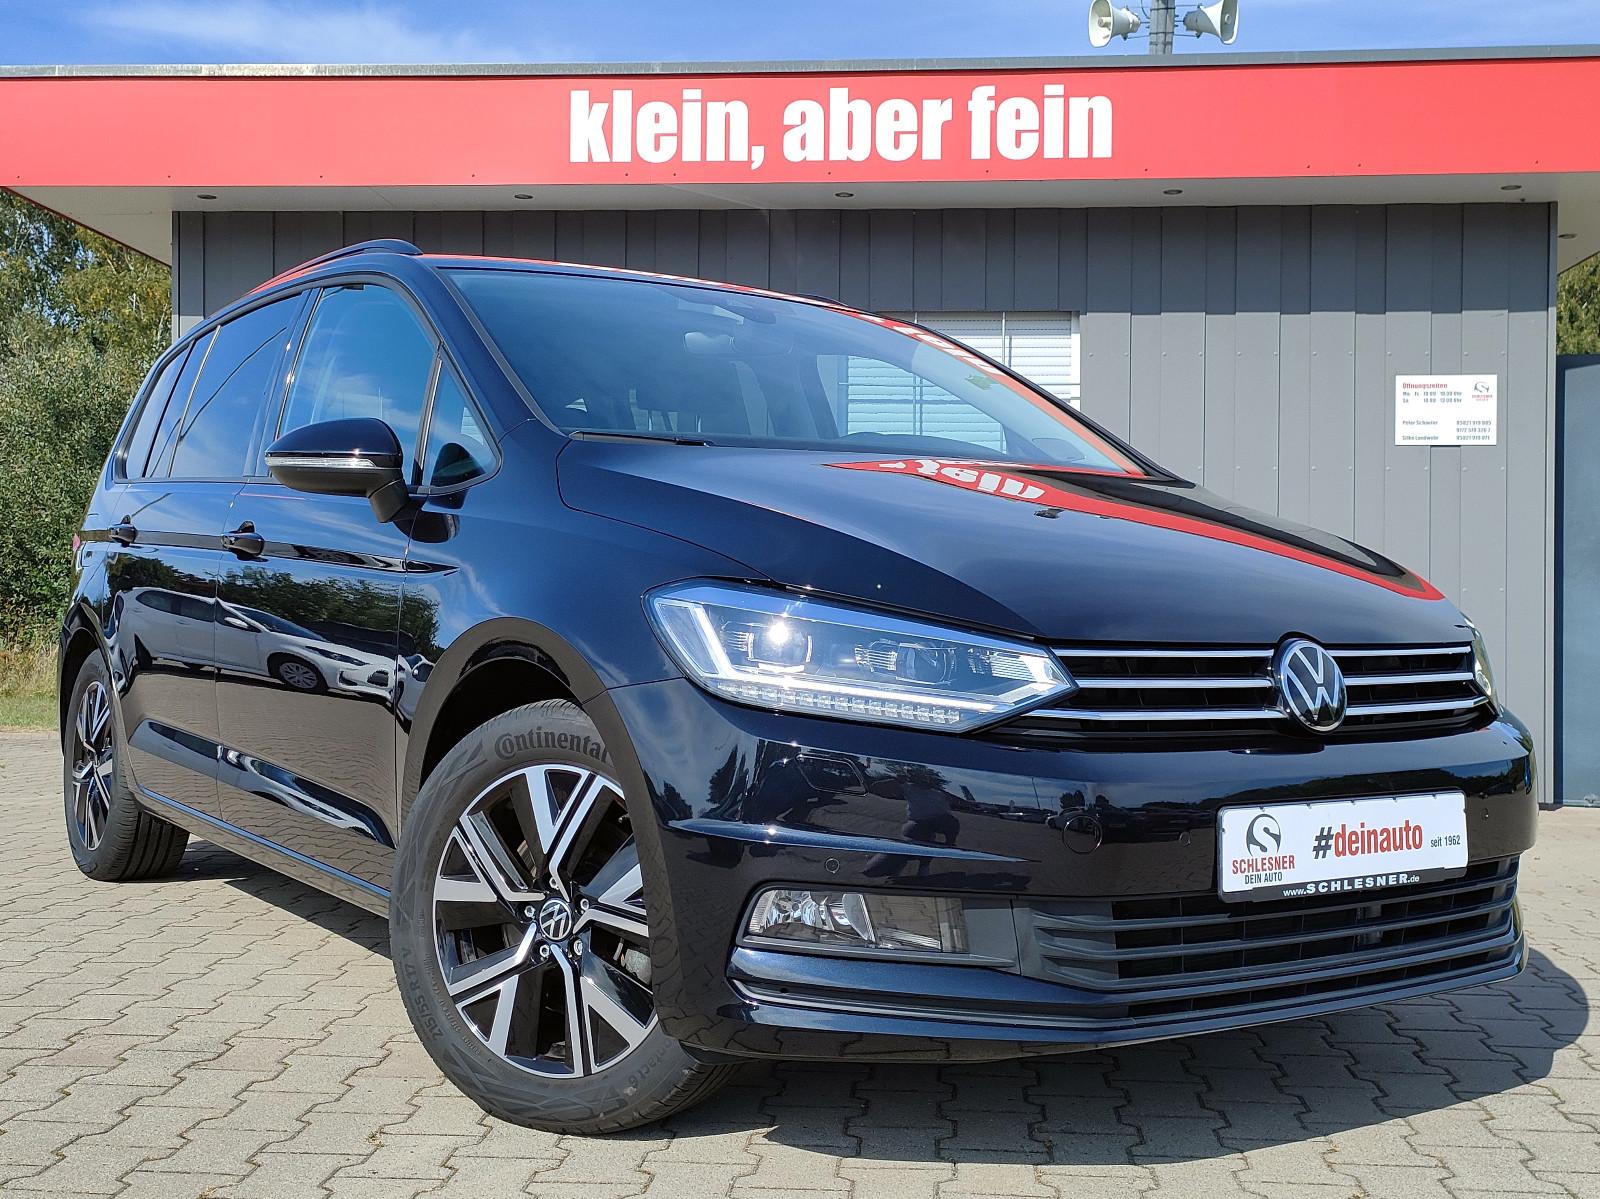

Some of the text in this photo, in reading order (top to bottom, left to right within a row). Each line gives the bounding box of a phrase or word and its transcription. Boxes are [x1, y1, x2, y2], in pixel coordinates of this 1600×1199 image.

[569, 84, 1113, 171] klein, aber fein
[1402, 382, 1448, 390] Öffnungszeiten
[494, 725, 608, 763] Continental
[1312, 820, 1461, 860] #deinauto seit 1962
[1232, 855, 1295, 875] SCHLESNER
[1244, 871, 1283, 885] DEIN AUTO
[1283, 873, 1420, 897] www.SCHLESNER.de
[414, 995, 444, 1040] 215/55
